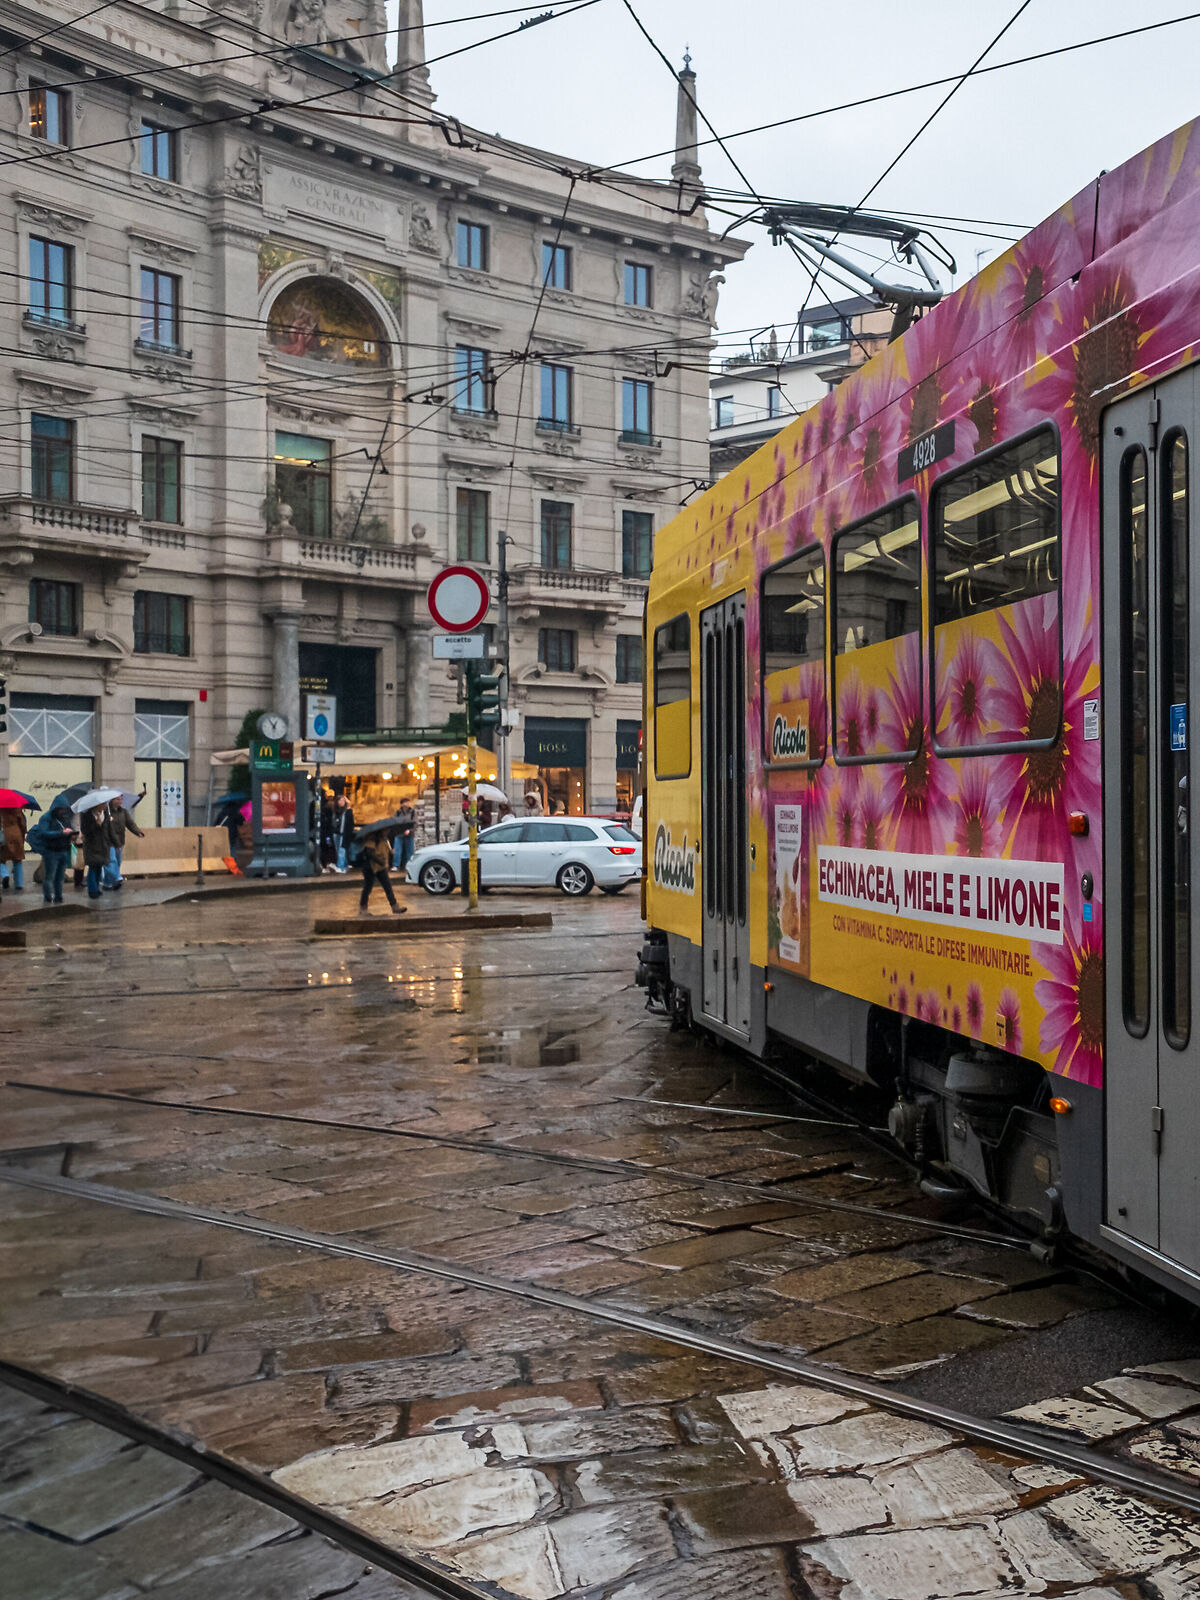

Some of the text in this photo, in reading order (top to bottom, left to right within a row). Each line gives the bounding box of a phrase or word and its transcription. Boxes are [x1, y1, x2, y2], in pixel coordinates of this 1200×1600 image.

[306, 195, 366, 224] GENERALI
[912, 433, 936, 471] 4928
[539, 743, 568, 753] BOSS
[772, 714, 807, 756] Ricola
[654, 821, 695, 894] Ricola
[819, 858, 1061, 931] ECHINACEA, MIELE E LIMONE
[833, 914, 1033, 977] CON VITAMINA C. SUPPORTA LE DIFESE IMMUNITARIE.
